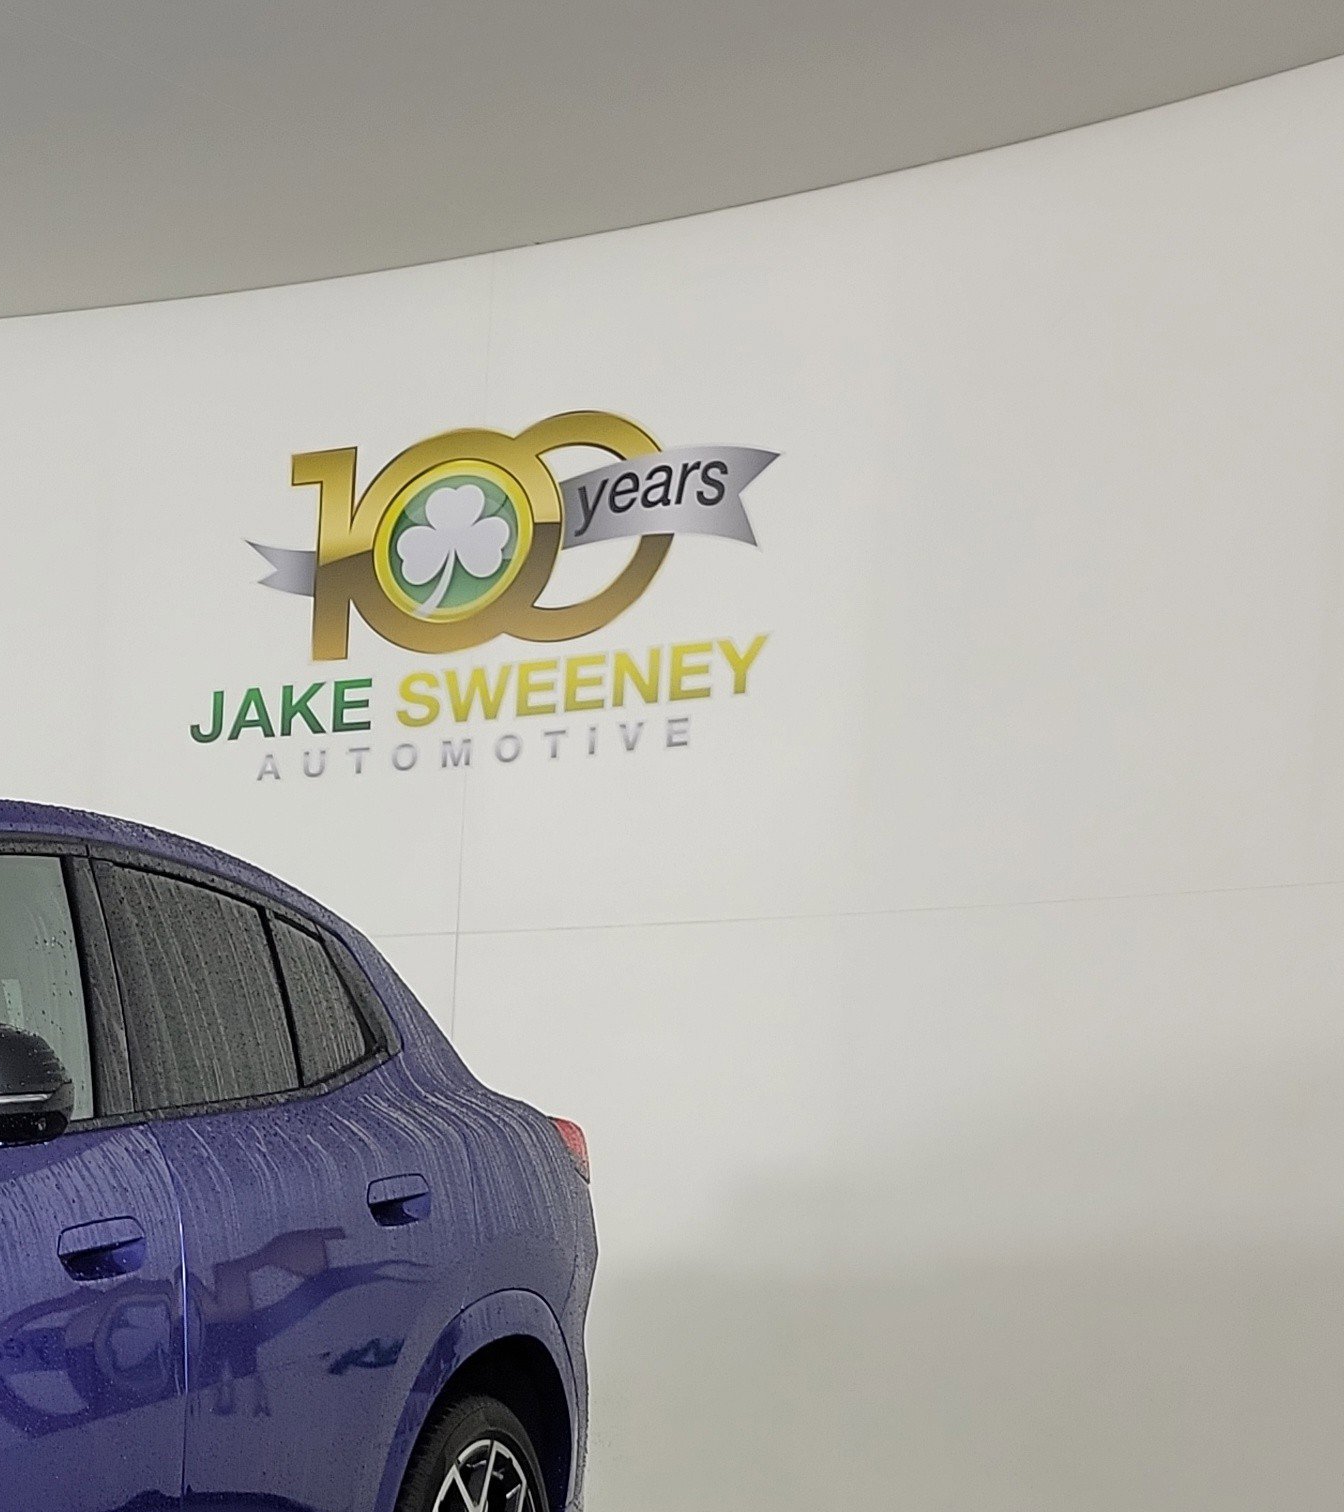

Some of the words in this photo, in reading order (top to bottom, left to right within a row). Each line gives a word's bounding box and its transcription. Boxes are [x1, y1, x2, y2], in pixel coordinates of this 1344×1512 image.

[291, 410, 675, 661] 100
[574, 458, 729, 536] years
[190, 677, 373, 744] JAKE
[395, 633, 770, 728] SWEENEY
[256, 718, 691, 781] AUTOMOTIVE
